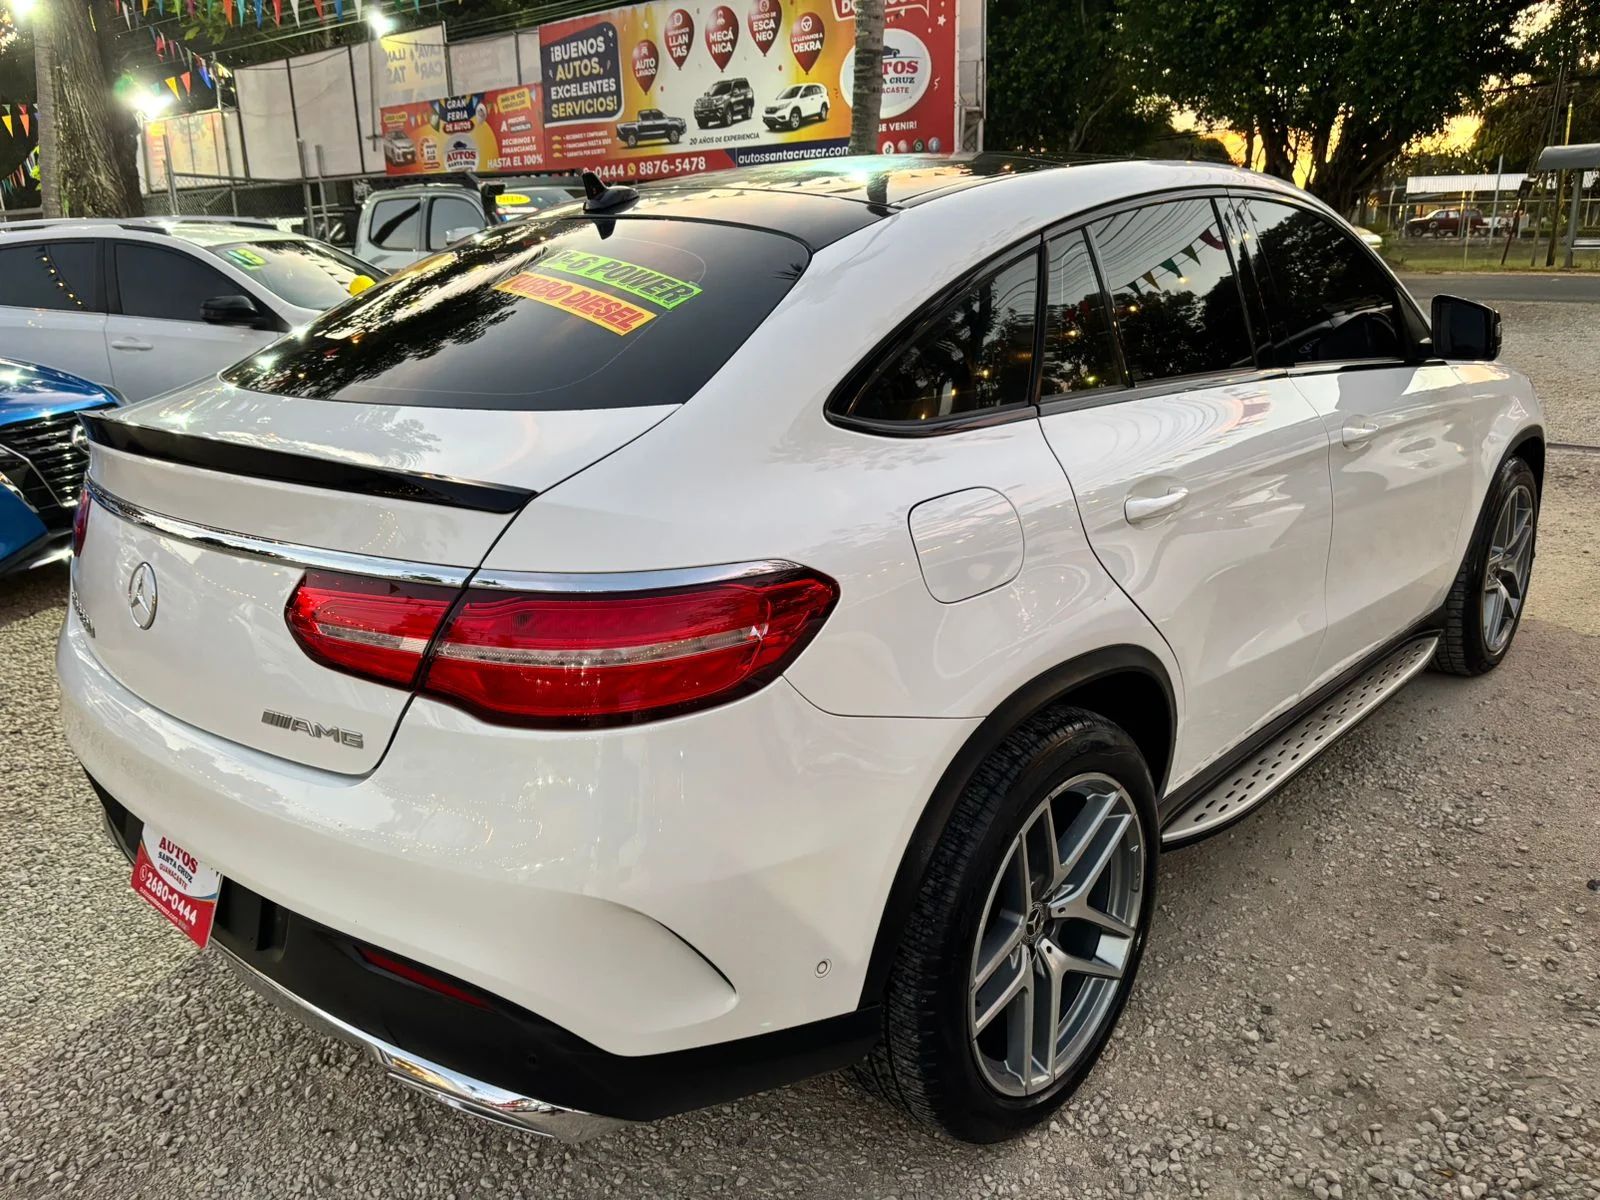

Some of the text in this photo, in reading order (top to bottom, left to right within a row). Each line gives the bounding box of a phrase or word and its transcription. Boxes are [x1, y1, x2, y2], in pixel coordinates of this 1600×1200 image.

[753, 19, 775, 31] ESCA
[669, 34, 688, 46] LLAN
[709, 27, 734, 42] MECÁ
[756, 31, 773, 42] NEO
[550, 36, 605, 62] ¡BUENOS
[671, 45, 687, 58] TAS
[711, 42, 732, 54] NICA
[793, 40, 821, 53] DEKRA
[556, 57, 603, 81] AUTOS,
[635, 58, 655, 69] AUTO
[882, 60, 918, 75] TOS
[550, 78, 616, 99] EXCELENTES
[446, 99, 466, 109] GRAN
[551, 95, 617, 118] SERVICIOS!
[447, 111, 468, 121] FERIA
[445, 121, 471, 132] DE AUTOS
[500, 120, 507, 132] A
[889, 121, 917, 130] VENIR!
[502, 136, 530, 146] RECIBIMOS
[723, 132, 760, 142] EXPERIENCIA
[502, 144, 536, 154] FINANCIAMOS
[447, 151, 476, 161] AUTOS
[487, 154, 543, 169] HASTA EL 100%
[639, 157, 706, 176] 8876-5478
[584, 260, 695, 306] POWER
[501, 273, 646, 333] TURBO DIESEL
[291, 717, 364, 749] AMG
[158, 836, 199, 874] AUTOS
[158, 851, 193, 884] SANTA CRUZ
[145, 872, 198, 926] 2680-0444
